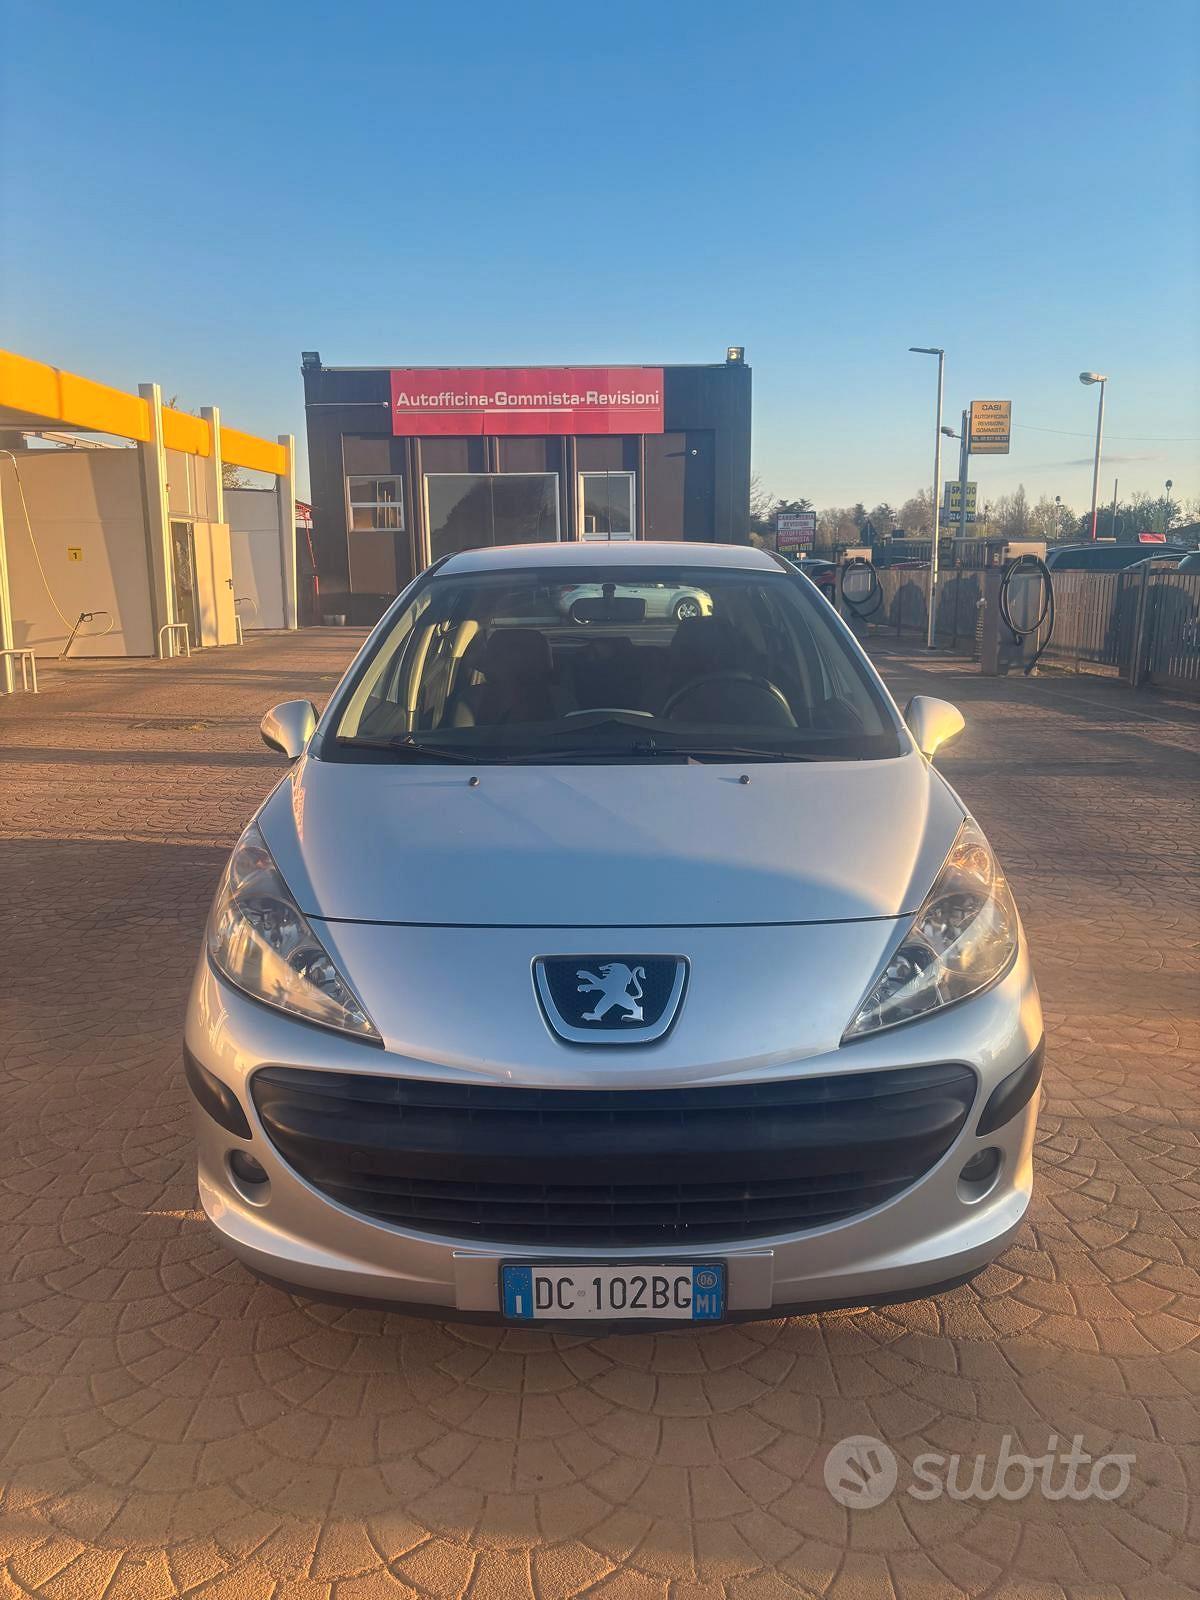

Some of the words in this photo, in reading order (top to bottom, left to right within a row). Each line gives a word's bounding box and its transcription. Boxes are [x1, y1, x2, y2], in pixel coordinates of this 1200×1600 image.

[396, 390, 660, 406] Autofficina-Gommista-Revisioni
[951, 485, 977, 495] SPZIO
[950, 498, 976, 508] LIBRO
[72, 551, 78, 560] 1
[698, 1274, 714, 1286] 06
[535, 1277, 575, 1310] DC
[592, 1275, 692, 1310] 102BG
[696, 1294, 717, 1313] MI
